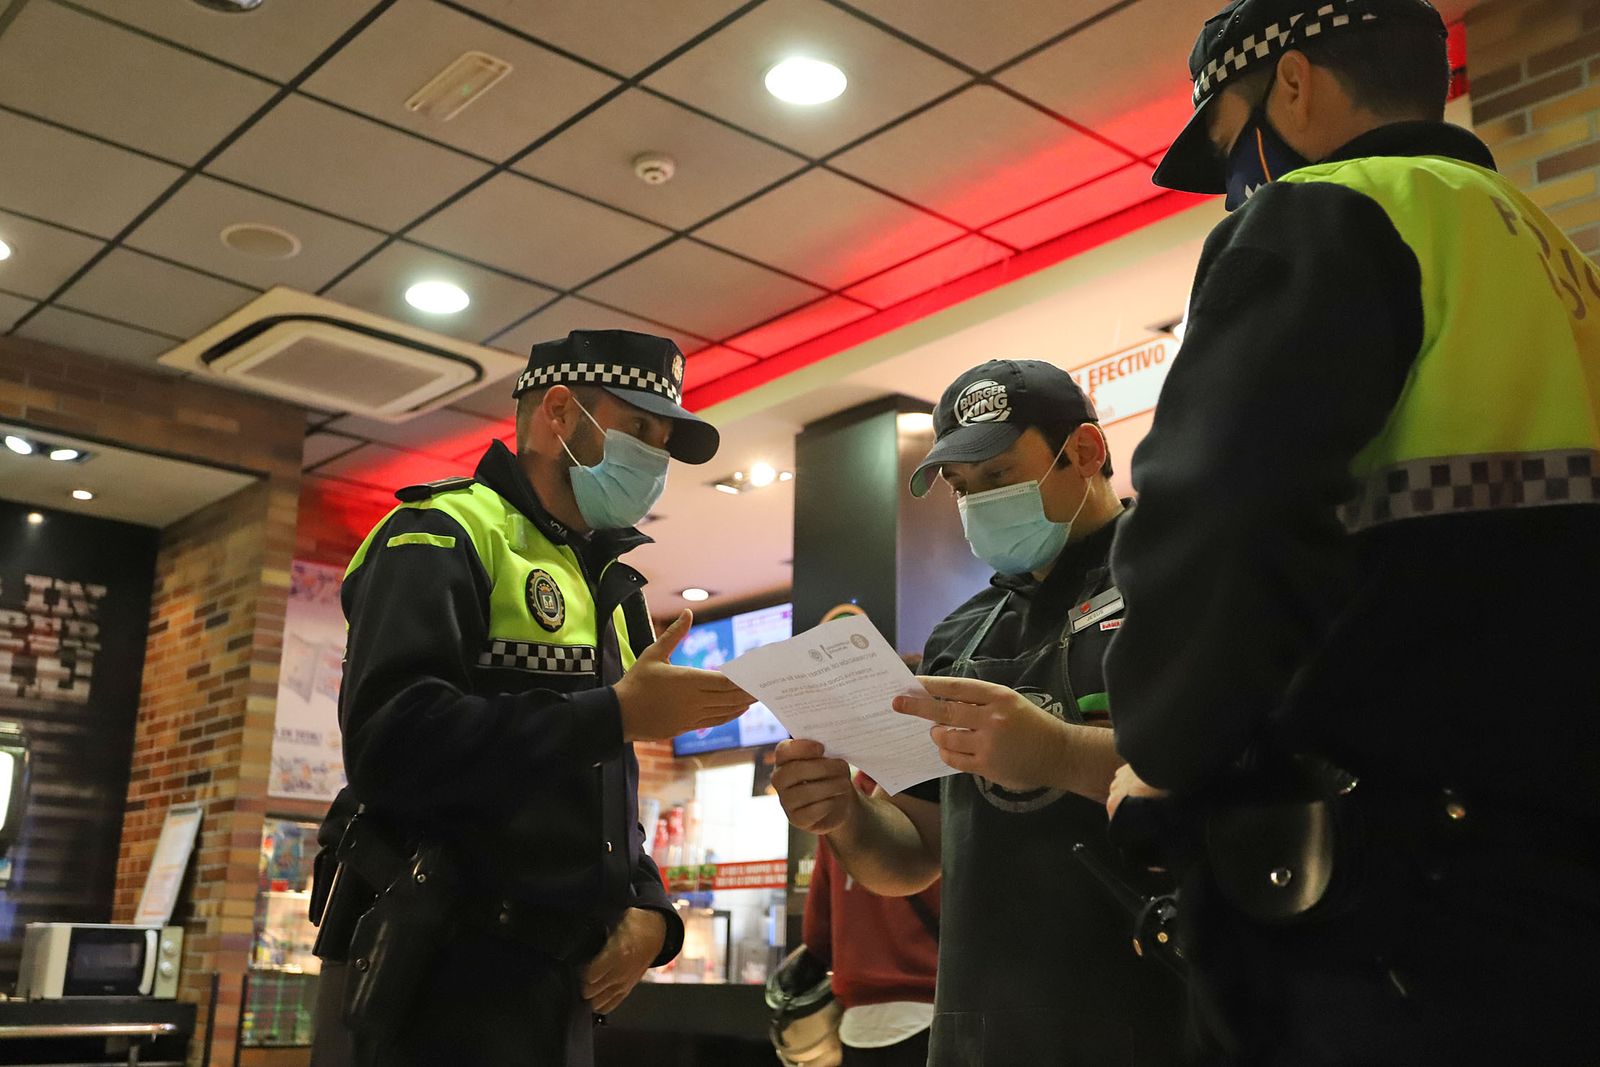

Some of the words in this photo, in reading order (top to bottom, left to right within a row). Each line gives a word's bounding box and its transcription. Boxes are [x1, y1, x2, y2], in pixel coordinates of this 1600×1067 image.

[1088, 343, 1166, 386] EFECTIVO
[960, 385, 1006, 411] BURGER
[962, 393, 1008, 421] KING
